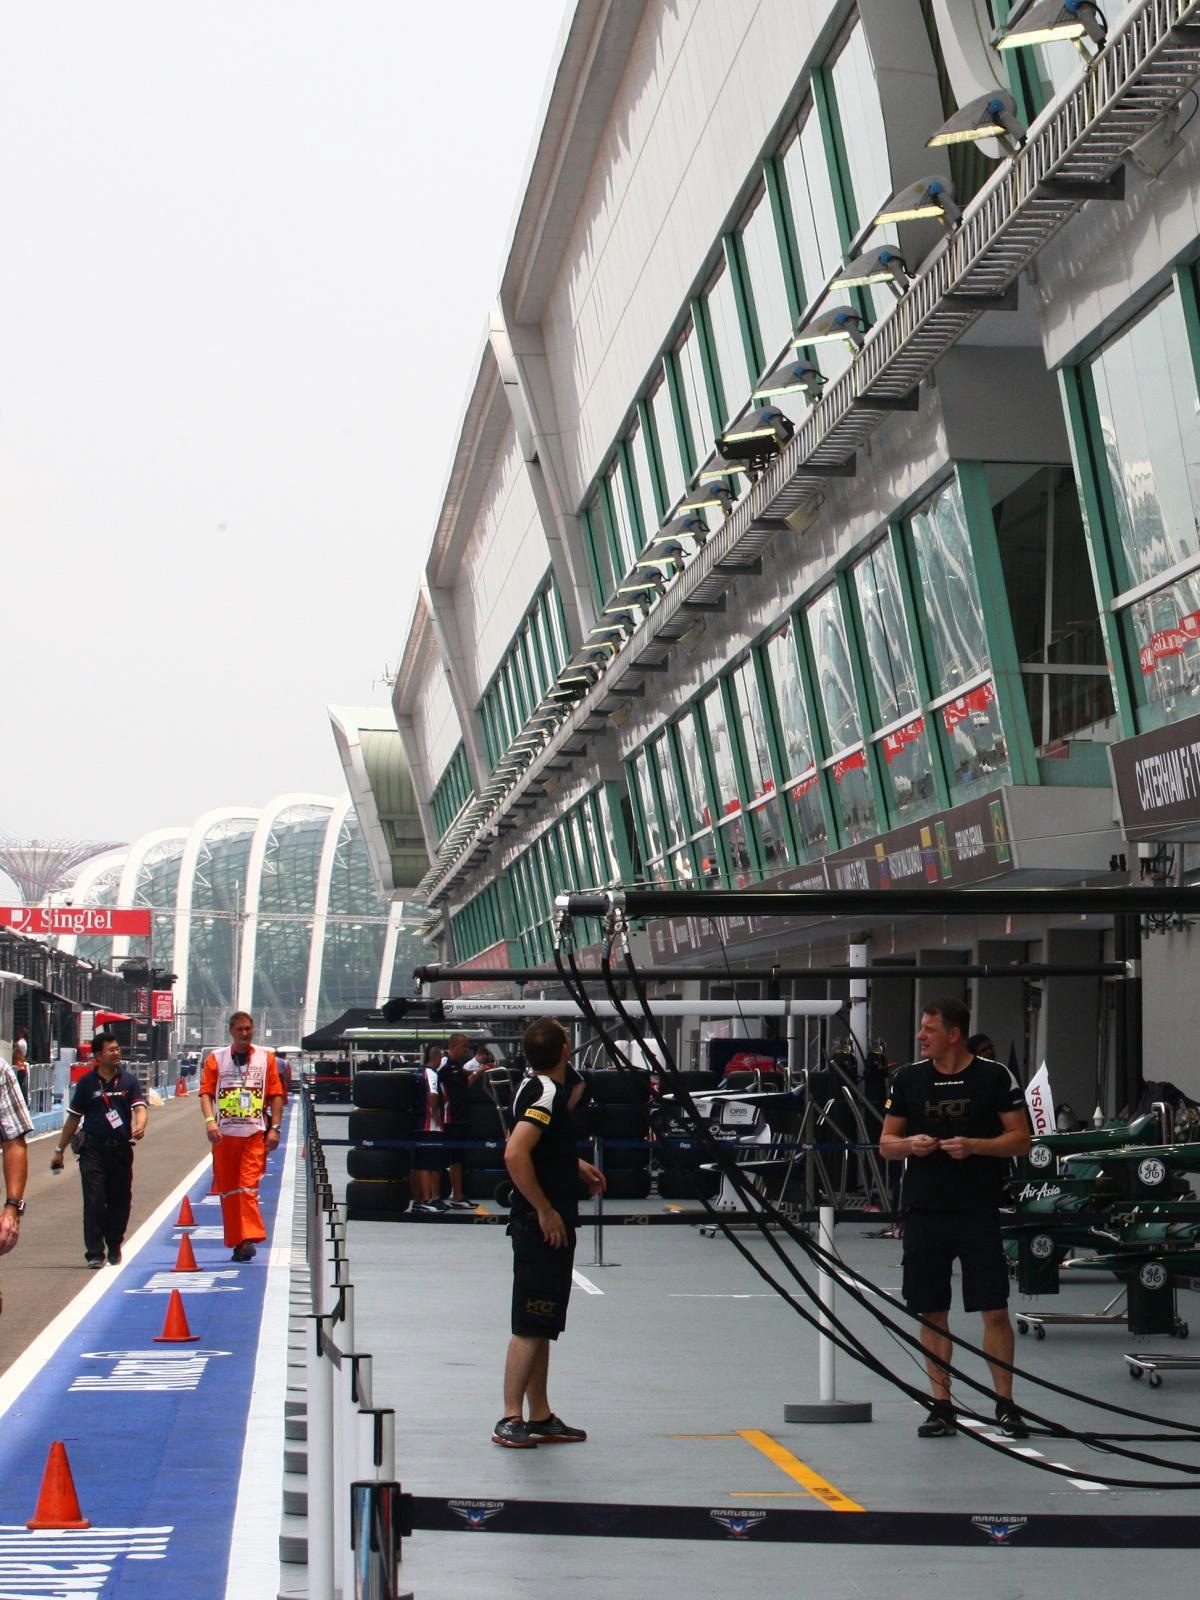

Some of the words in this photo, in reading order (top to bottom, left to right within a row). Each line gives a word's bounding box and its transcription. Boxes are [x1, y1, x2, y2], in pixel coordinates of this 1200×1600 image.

[1135, 748, 1187, 811] CATERHAM
[1180, 745, 1197, 800] F1
[40, 908, 113, 934] SingTel
[730, 1107, 748, 1115] ORIS
[448, 1500, 504, 1508] MARUSSIA
[710, 1509, 767, 1517] MARUSSIA
[971, 1515, 1028, 1523] MARUSSIA
